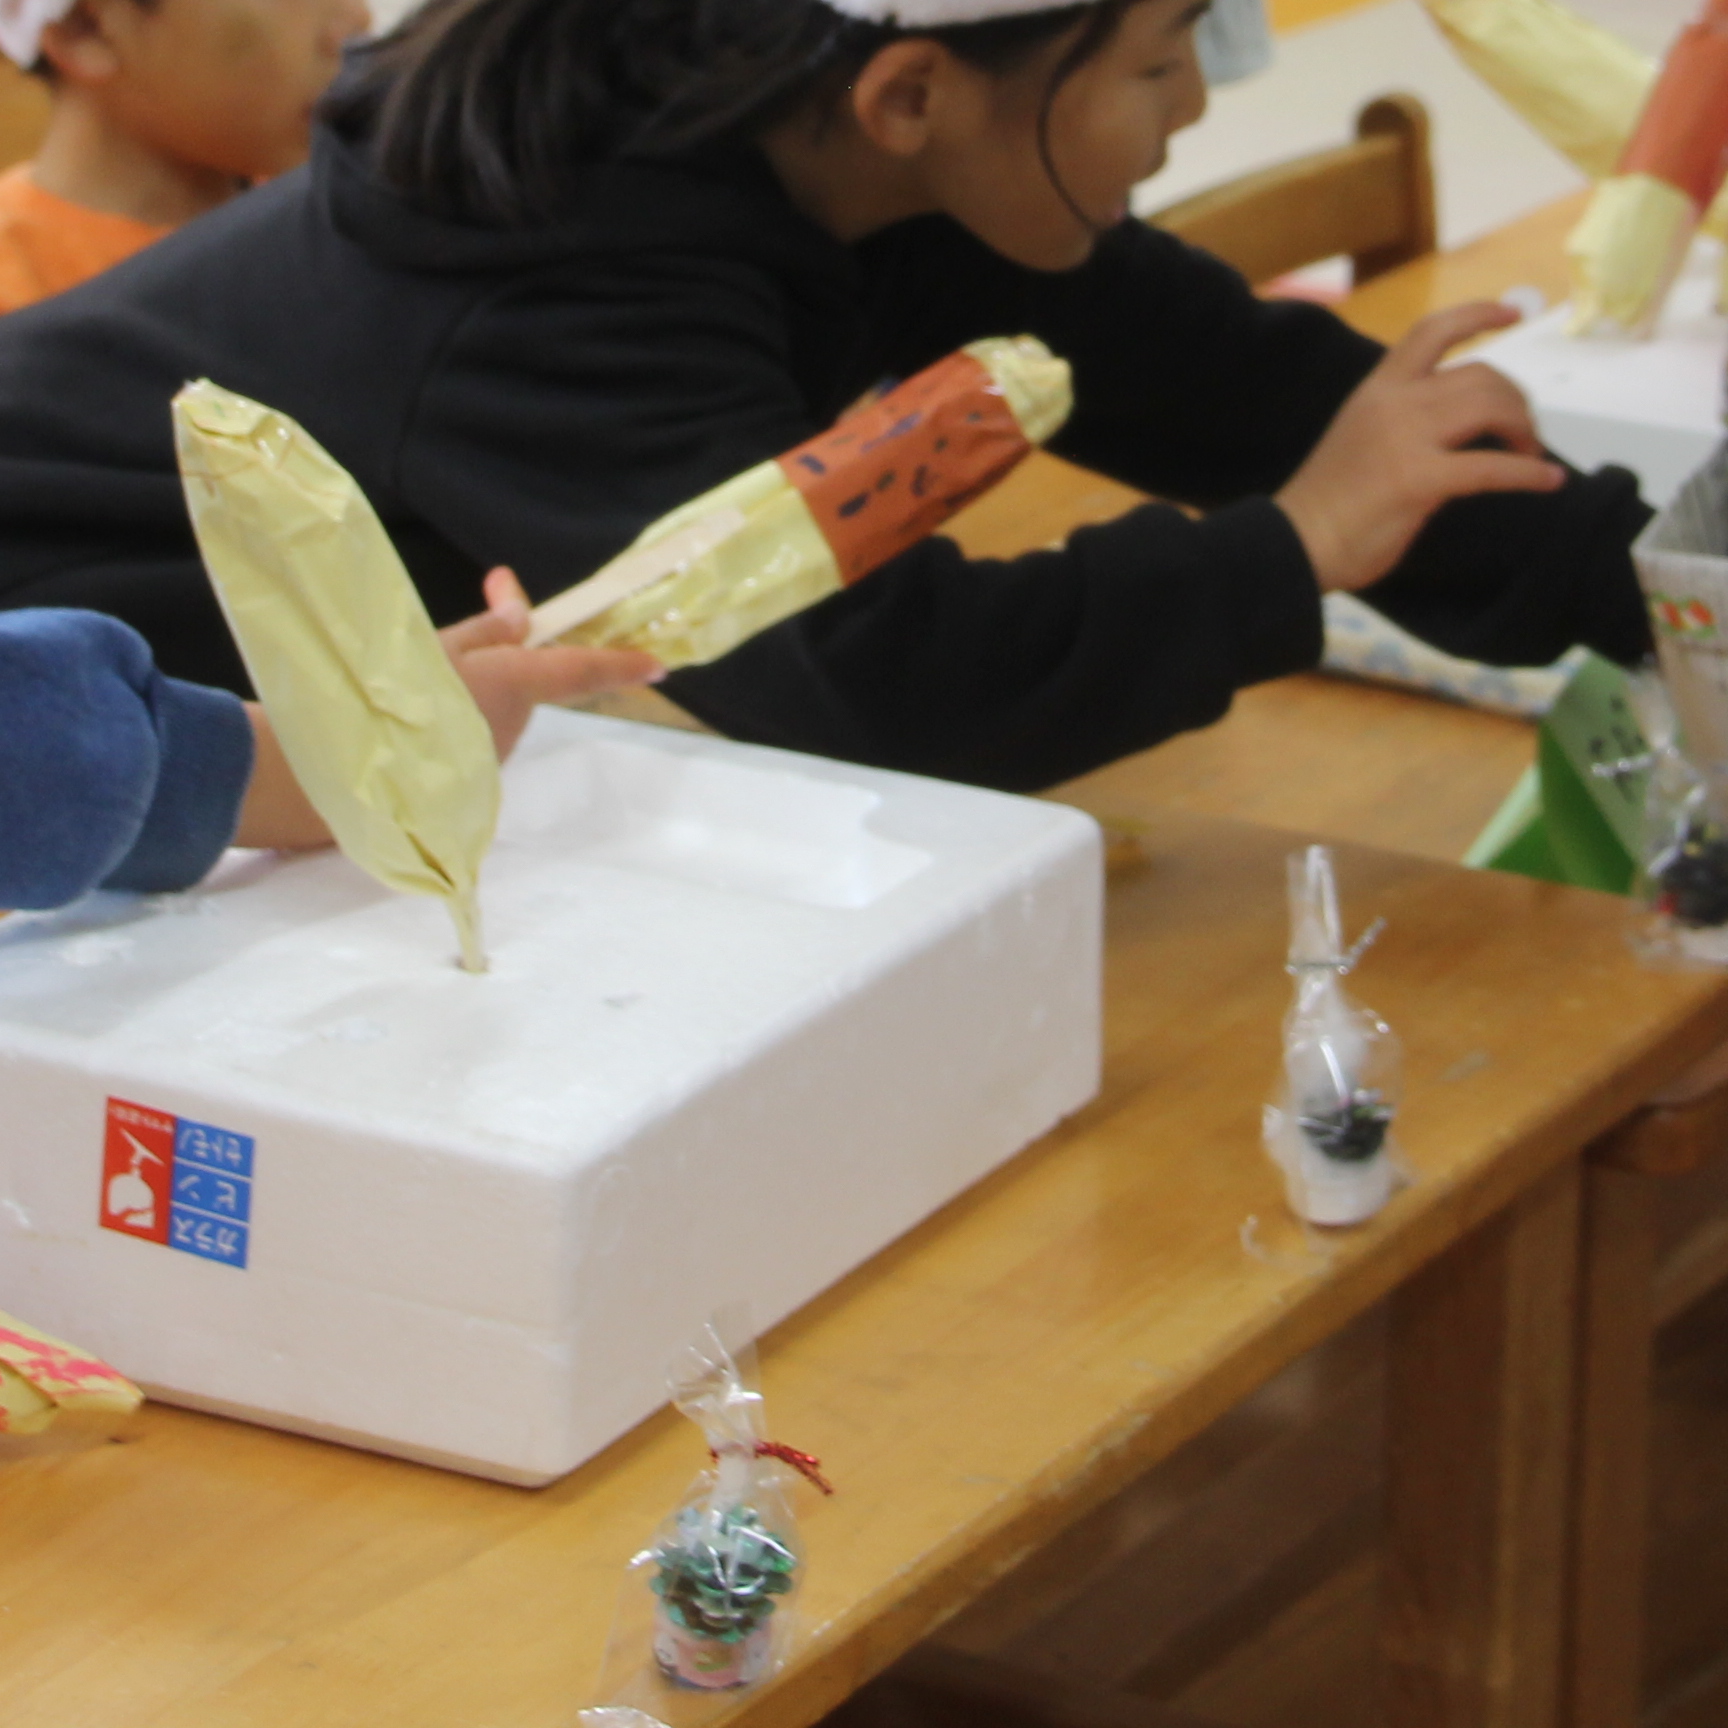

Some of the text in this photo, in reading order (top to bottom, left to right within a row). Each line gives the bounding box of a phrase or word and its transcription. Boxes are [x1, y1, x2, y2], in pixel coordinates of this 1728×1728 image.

[178, 1128, 243, 1168] セトモノ
[177, 1174, 238, 1212] ビン
[174, 1215, 240, 1257] ガラス
